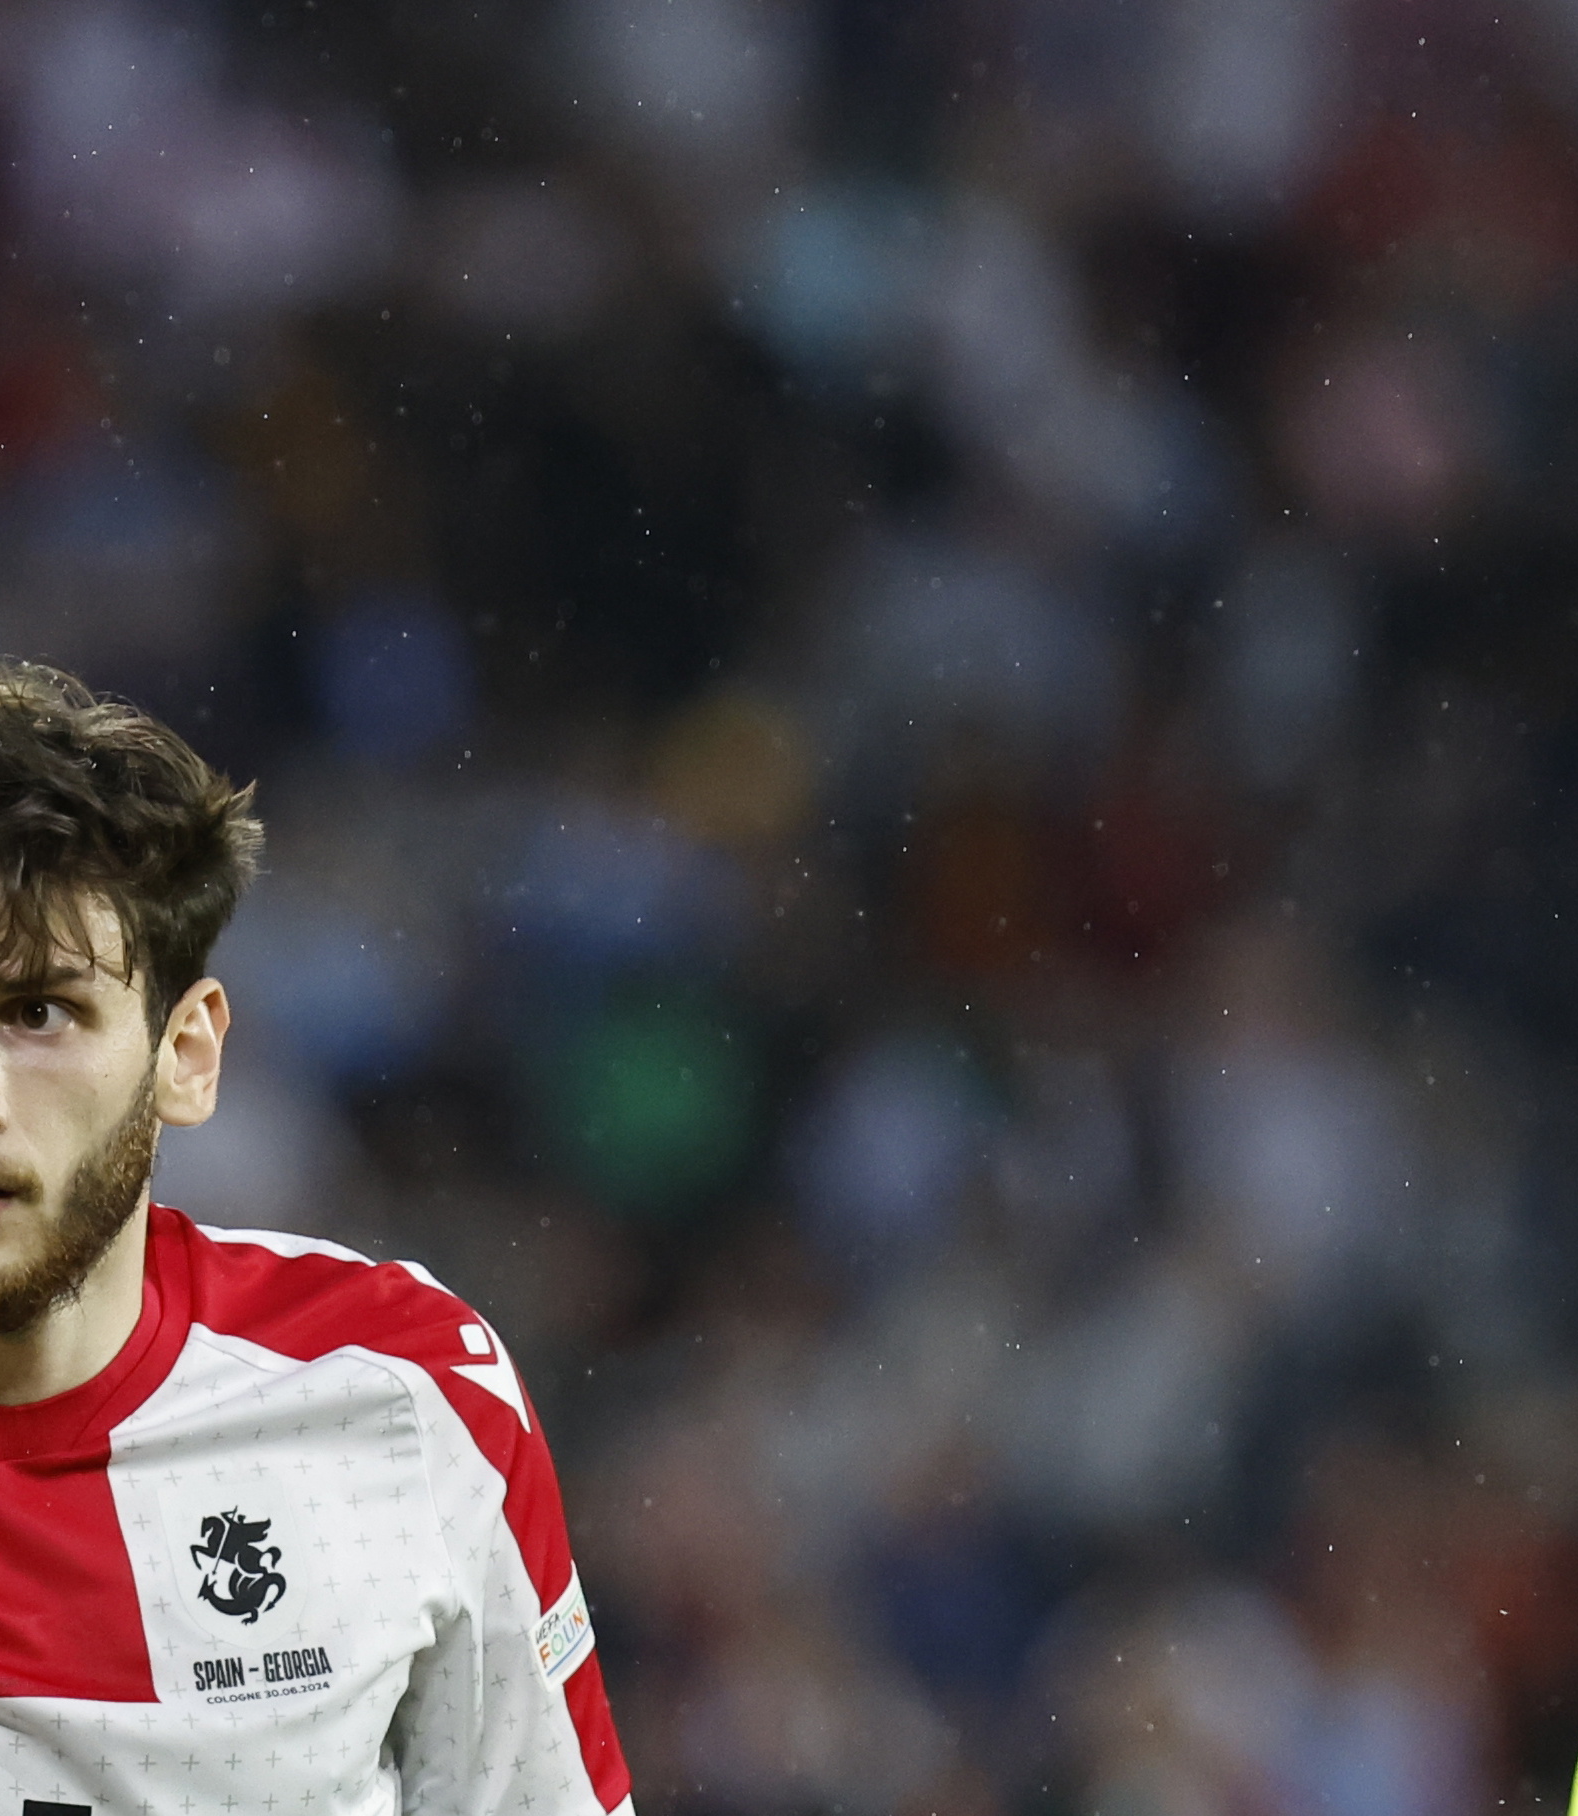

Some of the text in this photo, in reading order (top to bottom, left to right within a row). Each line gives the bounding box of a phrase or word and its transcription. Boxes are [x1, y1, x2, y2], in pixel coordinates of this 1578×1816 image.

[193, 1656, 245, 1692] SPAIN
[262, 1646, 333, 1683] GEORGIA
[206, 1681, 331, 1705] COLOGNE 30.06.2024
